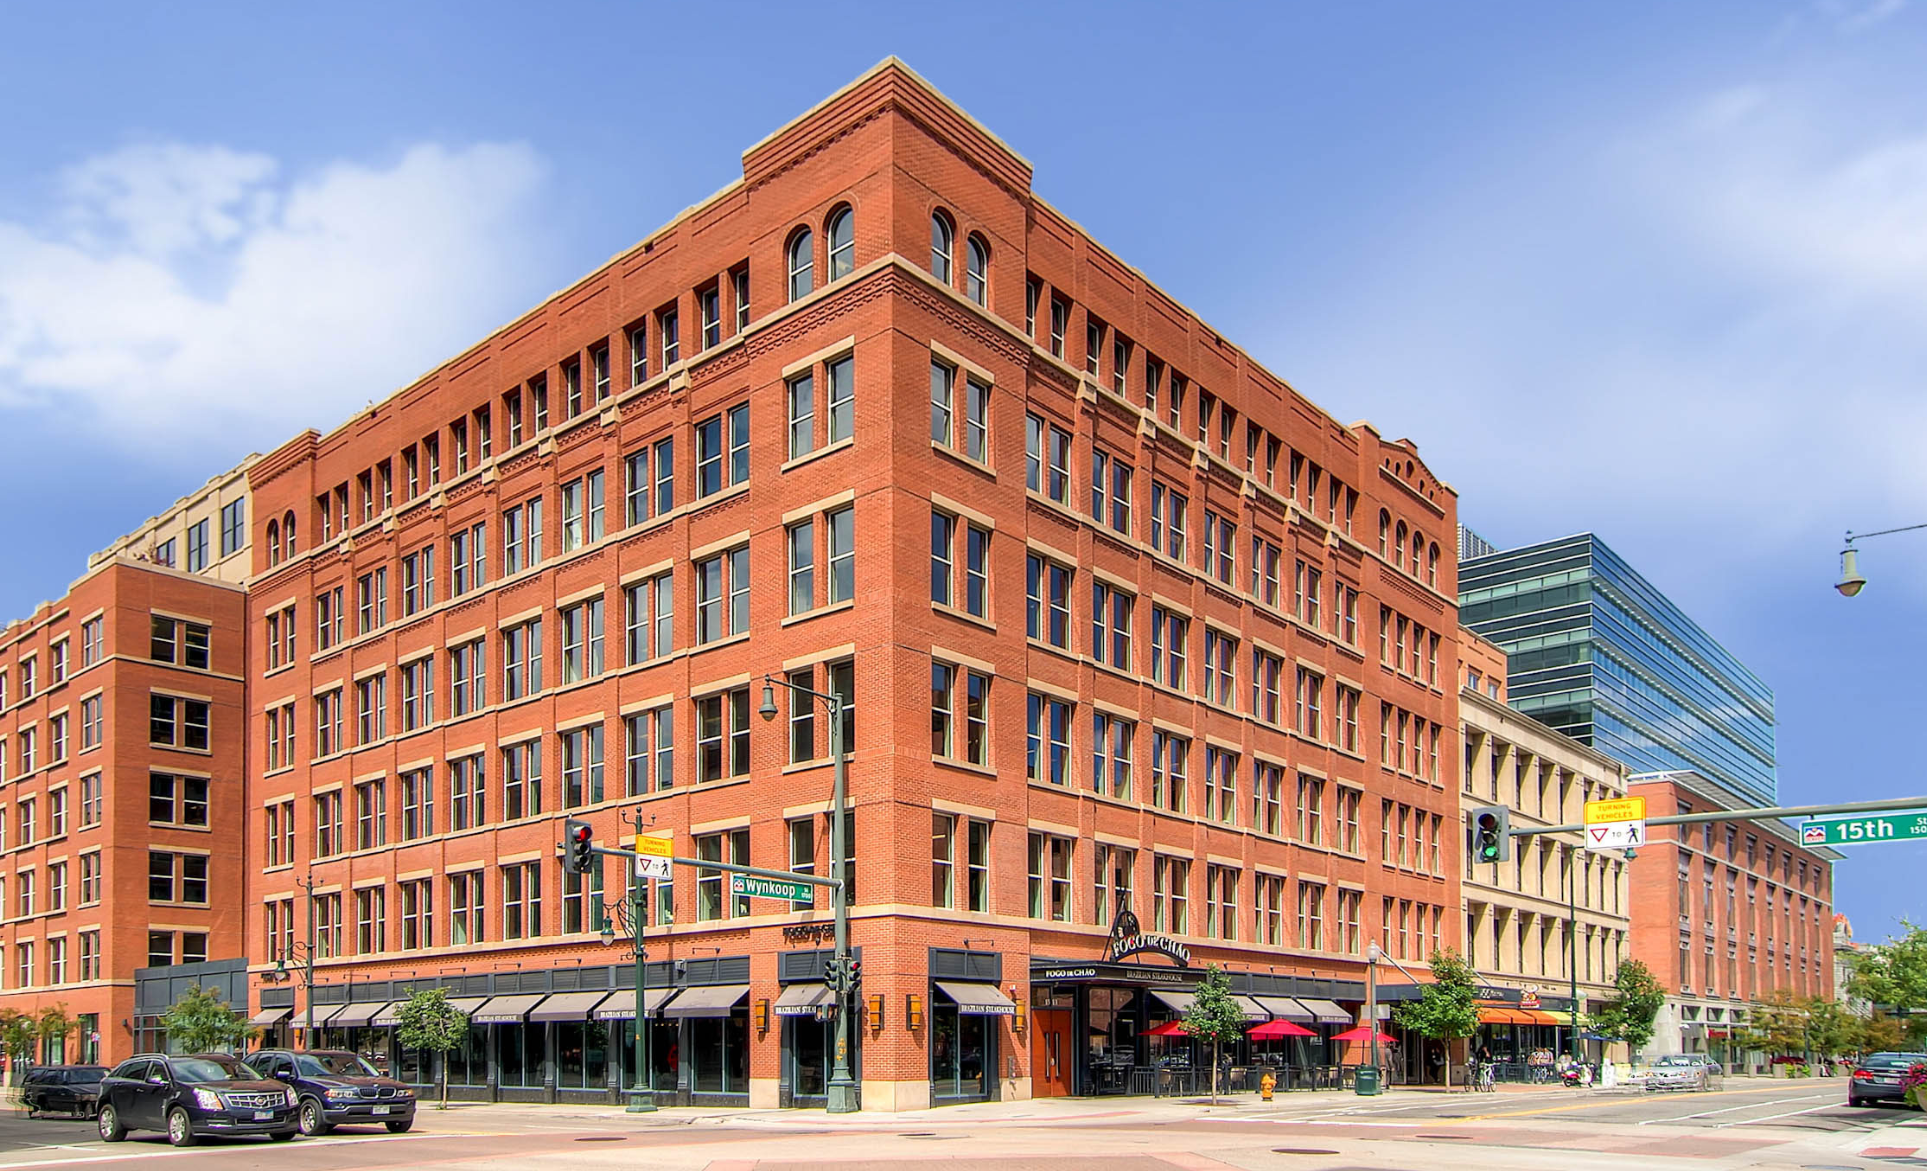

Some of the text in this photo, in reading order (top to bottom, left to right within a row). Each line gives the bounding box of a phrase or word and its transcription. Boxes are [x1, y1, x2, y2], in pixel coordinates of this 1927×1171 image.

[1598, 803, 1632, 811] TURNING
[1596, 812, 1633, 820] VEHICLES
[1917, 817, 1927, 825] St
[1836, 819, 1894, 840] 15th
[645, 839, 665, 847] TURNING
[746, 878, 796, 899] Wynkoop
[1113, 934, 1144, 957] FOGO
[1046, 970, 1067, 978] FOGO
[1127, 970, 1183, 981] BRAZILIAN STEAKHOUSE
[775, 1006, 800, 1015] BRAZILIAN
[961, 1004, 1015, 1014] BRAZILIAN STEAKHOUSE
